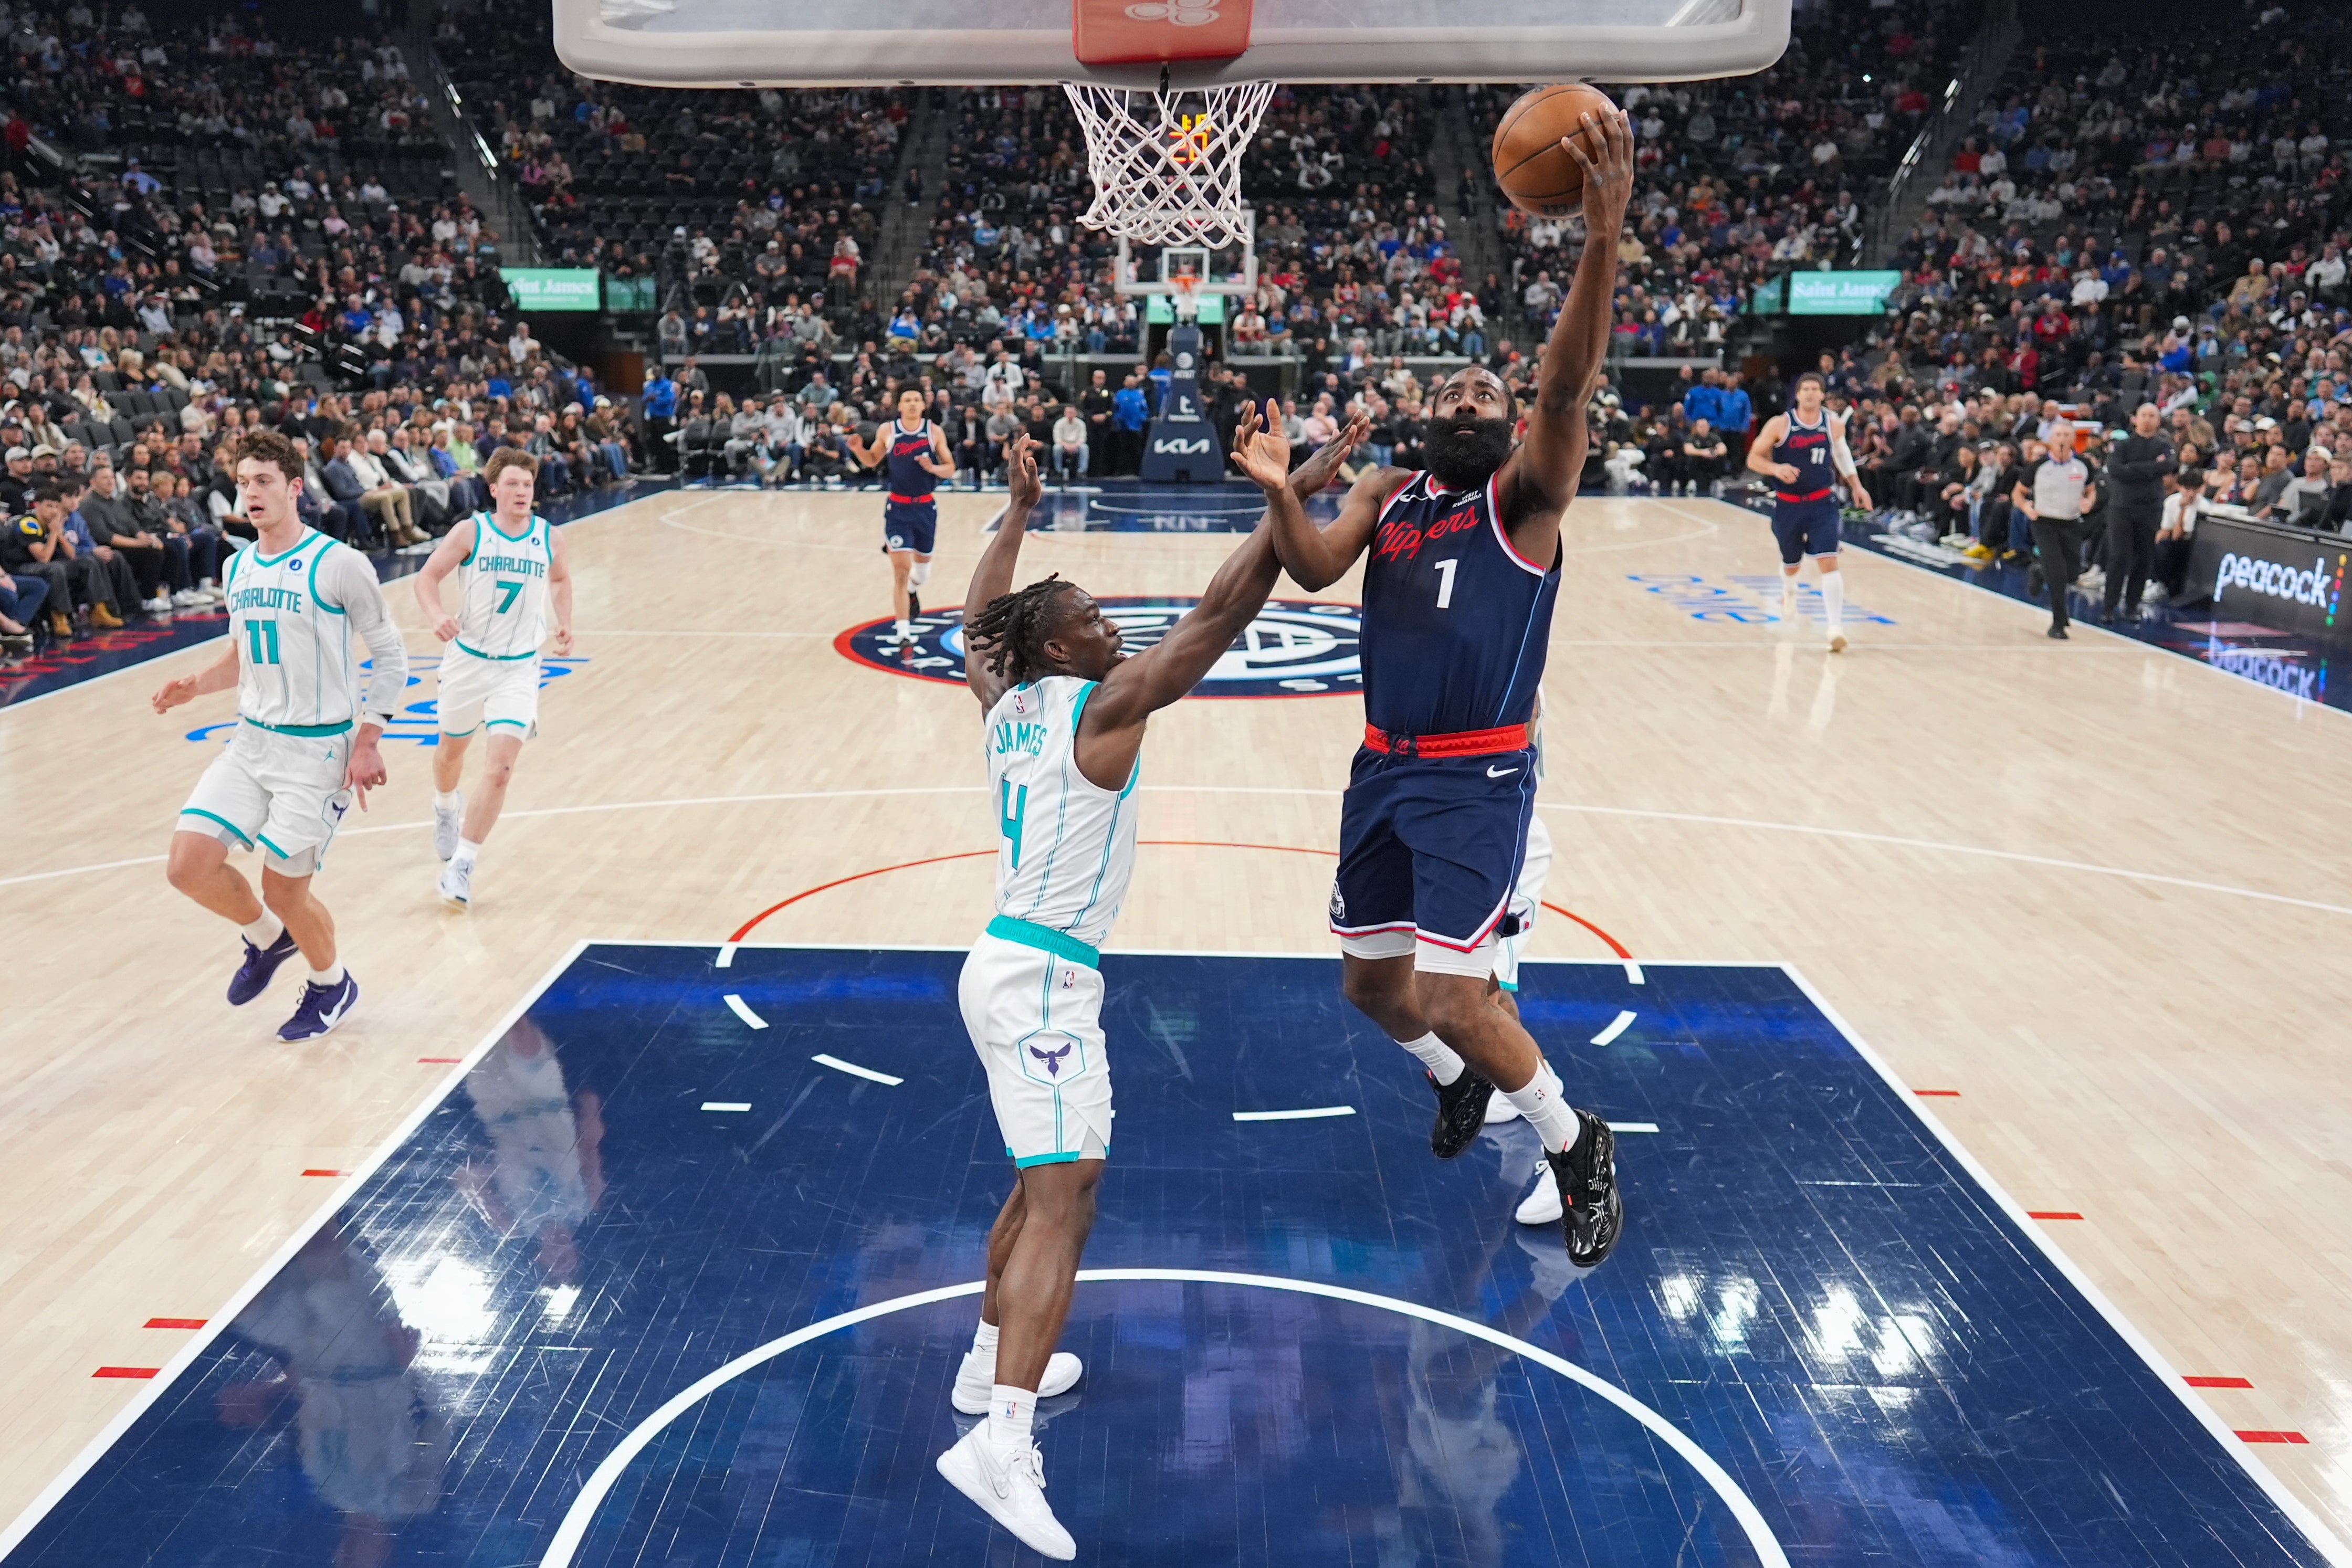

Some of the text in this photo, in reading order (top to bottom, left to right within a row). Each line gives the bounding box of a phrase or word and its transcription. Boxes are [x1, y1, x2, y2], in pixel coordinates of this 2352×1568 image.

[1810, 447, 1826, 464] 11
[1452, 493, 1482, 508] RWANDA
[1462, 490, 1478, 500] VISIT
[479, 556, 545, 578] CHARLOTTE
[2213, 553, 2331, 608] peacock
[496, 581, 523, 613] 7
[1434, 559, 1458, 608] 1
[231, 587, 301, 613] CHARLOTTE
[245, 620, 279, 664] 11
[995, 722, 1047, 757] JAMES
[1001, 778, 1028, 870] 4
